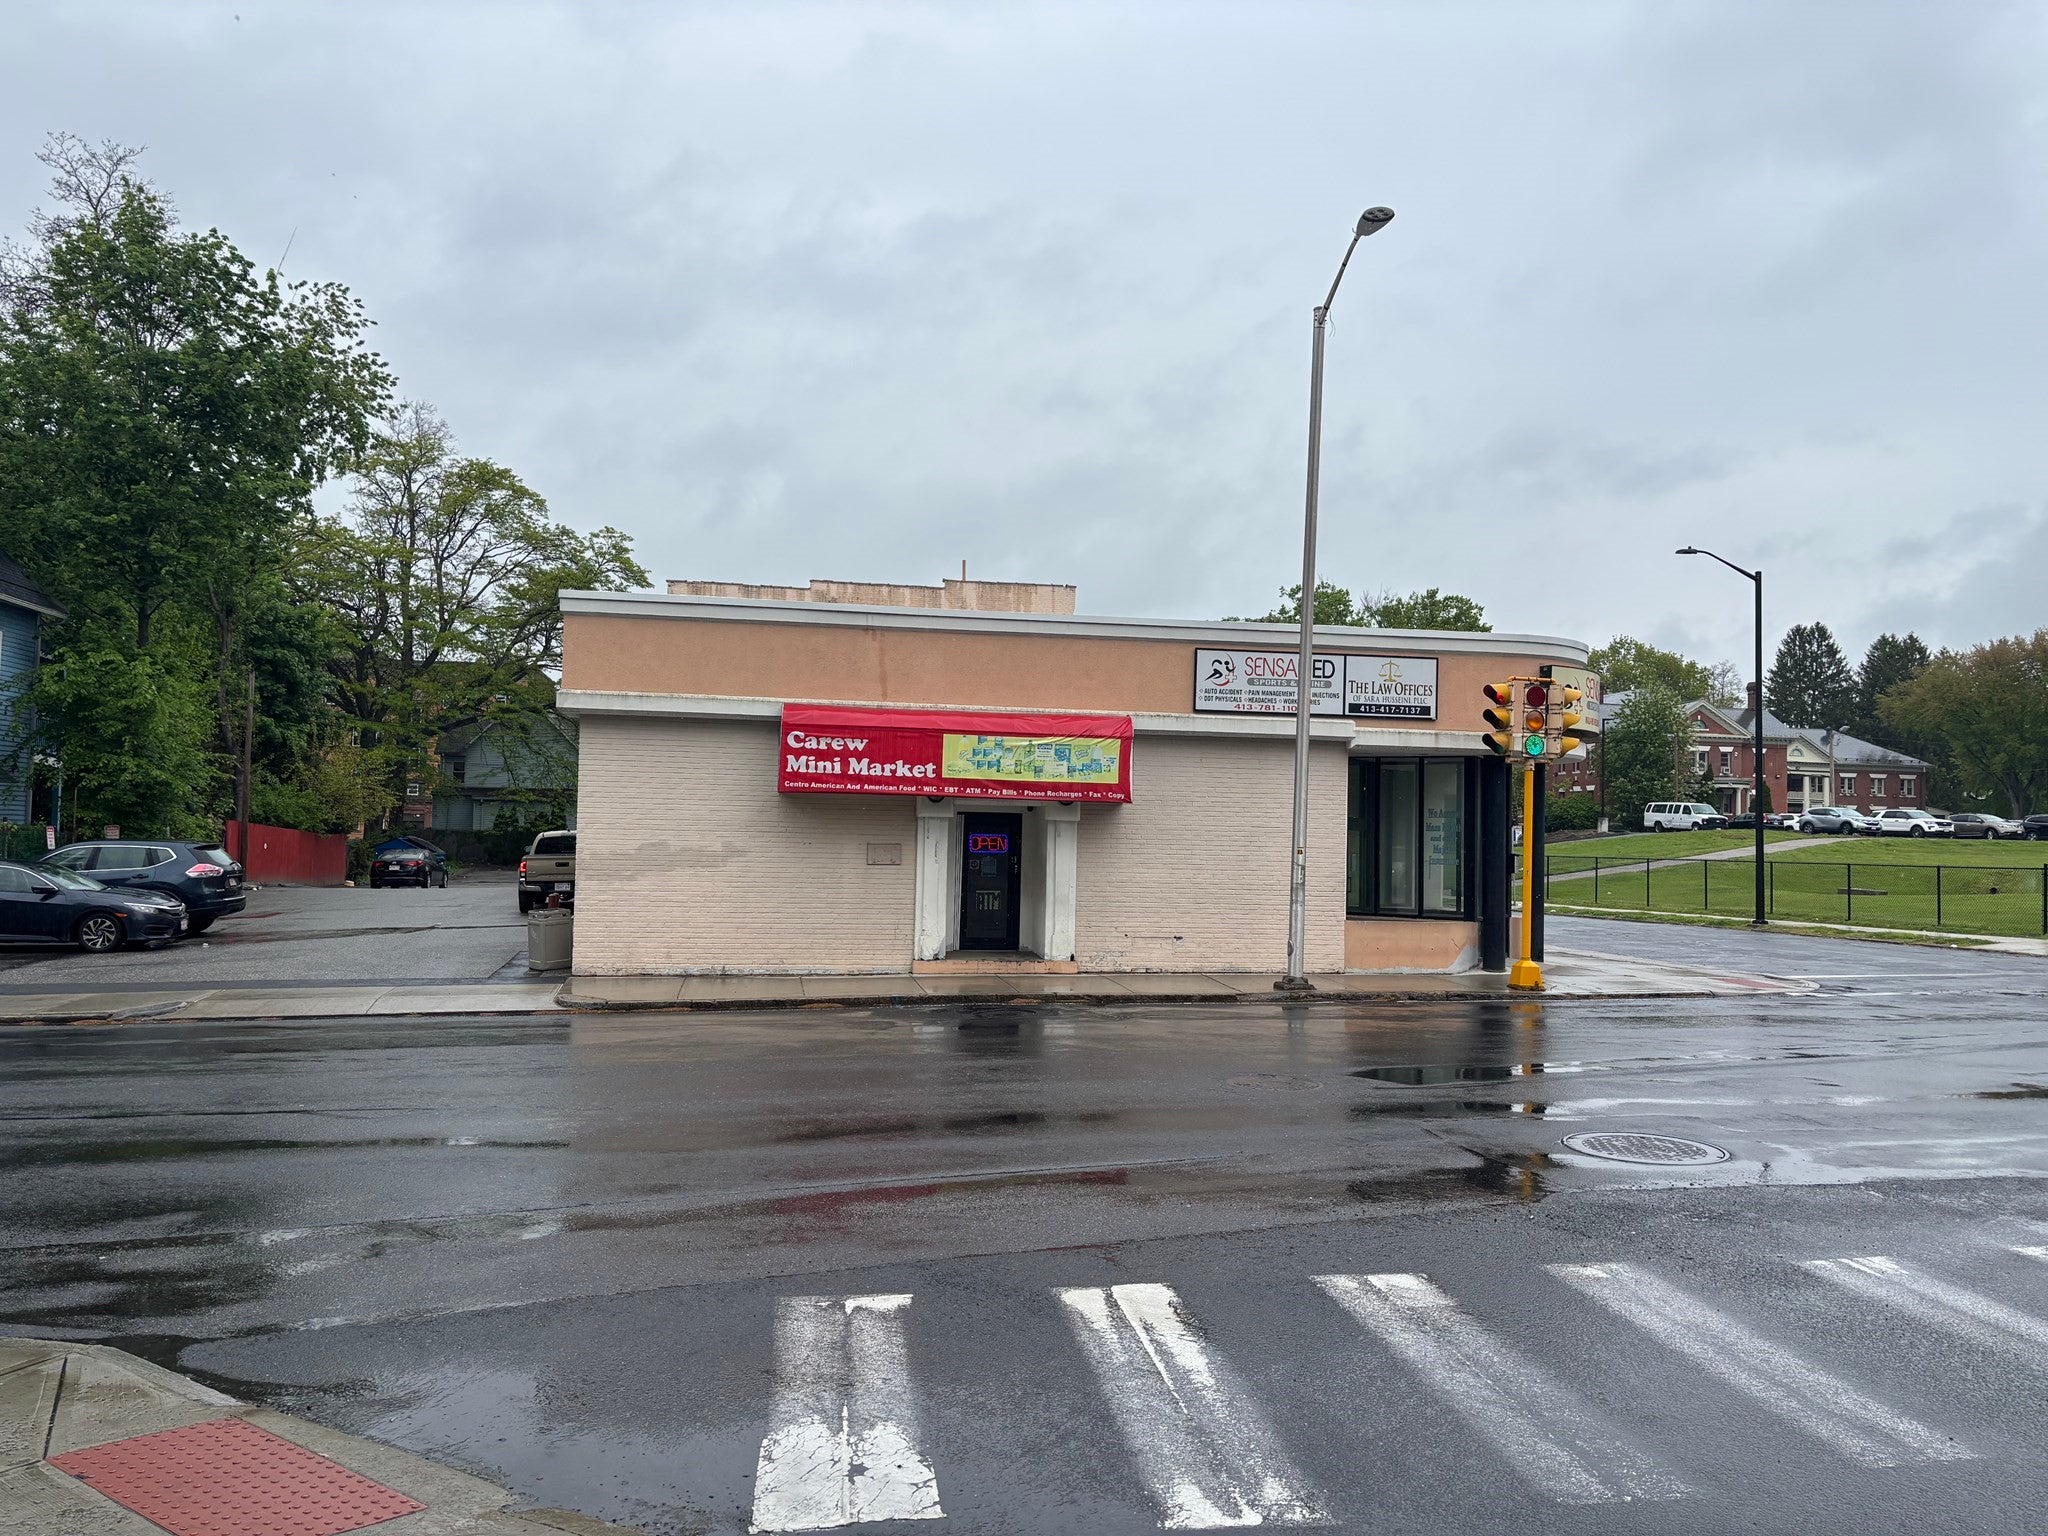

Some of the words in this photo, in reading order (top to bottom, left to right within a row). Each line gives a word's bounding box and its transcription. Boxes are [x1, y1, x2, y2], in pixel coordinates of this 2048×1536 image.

[1244, 656, 1336, 679] SENSAED
[1253, 679, 1288, 687] SPORTS
[1219, 688, 1243, 696] ACCIDENT
[1261, 690, 1296, 698] MANAGEMENT
[1364, 695, 1380, 703] SARA
[1413, 697, 1428, 705] PLLC
[1234, 703, 1298, 712] 413-781-110
[1360, 705, 1421, 714] 413-417-7137
[786, 731, 868, 751] Carew
[785, 755, 842, 775] Mini
[847, 757, 937, 778] Market
[784, 780, 809, 788] Centro
[811, 781, 845, 790] American
[923, 785, 938, 793] WIC
[988, 788, 1001, 796] Pay
[1024, 789, 1045, 797] Phone
[1047, 790, 1082, 798] Recharges
[1107, 792, 1125, 800] Copy
[971, 836, 1007, 851] OPEN
